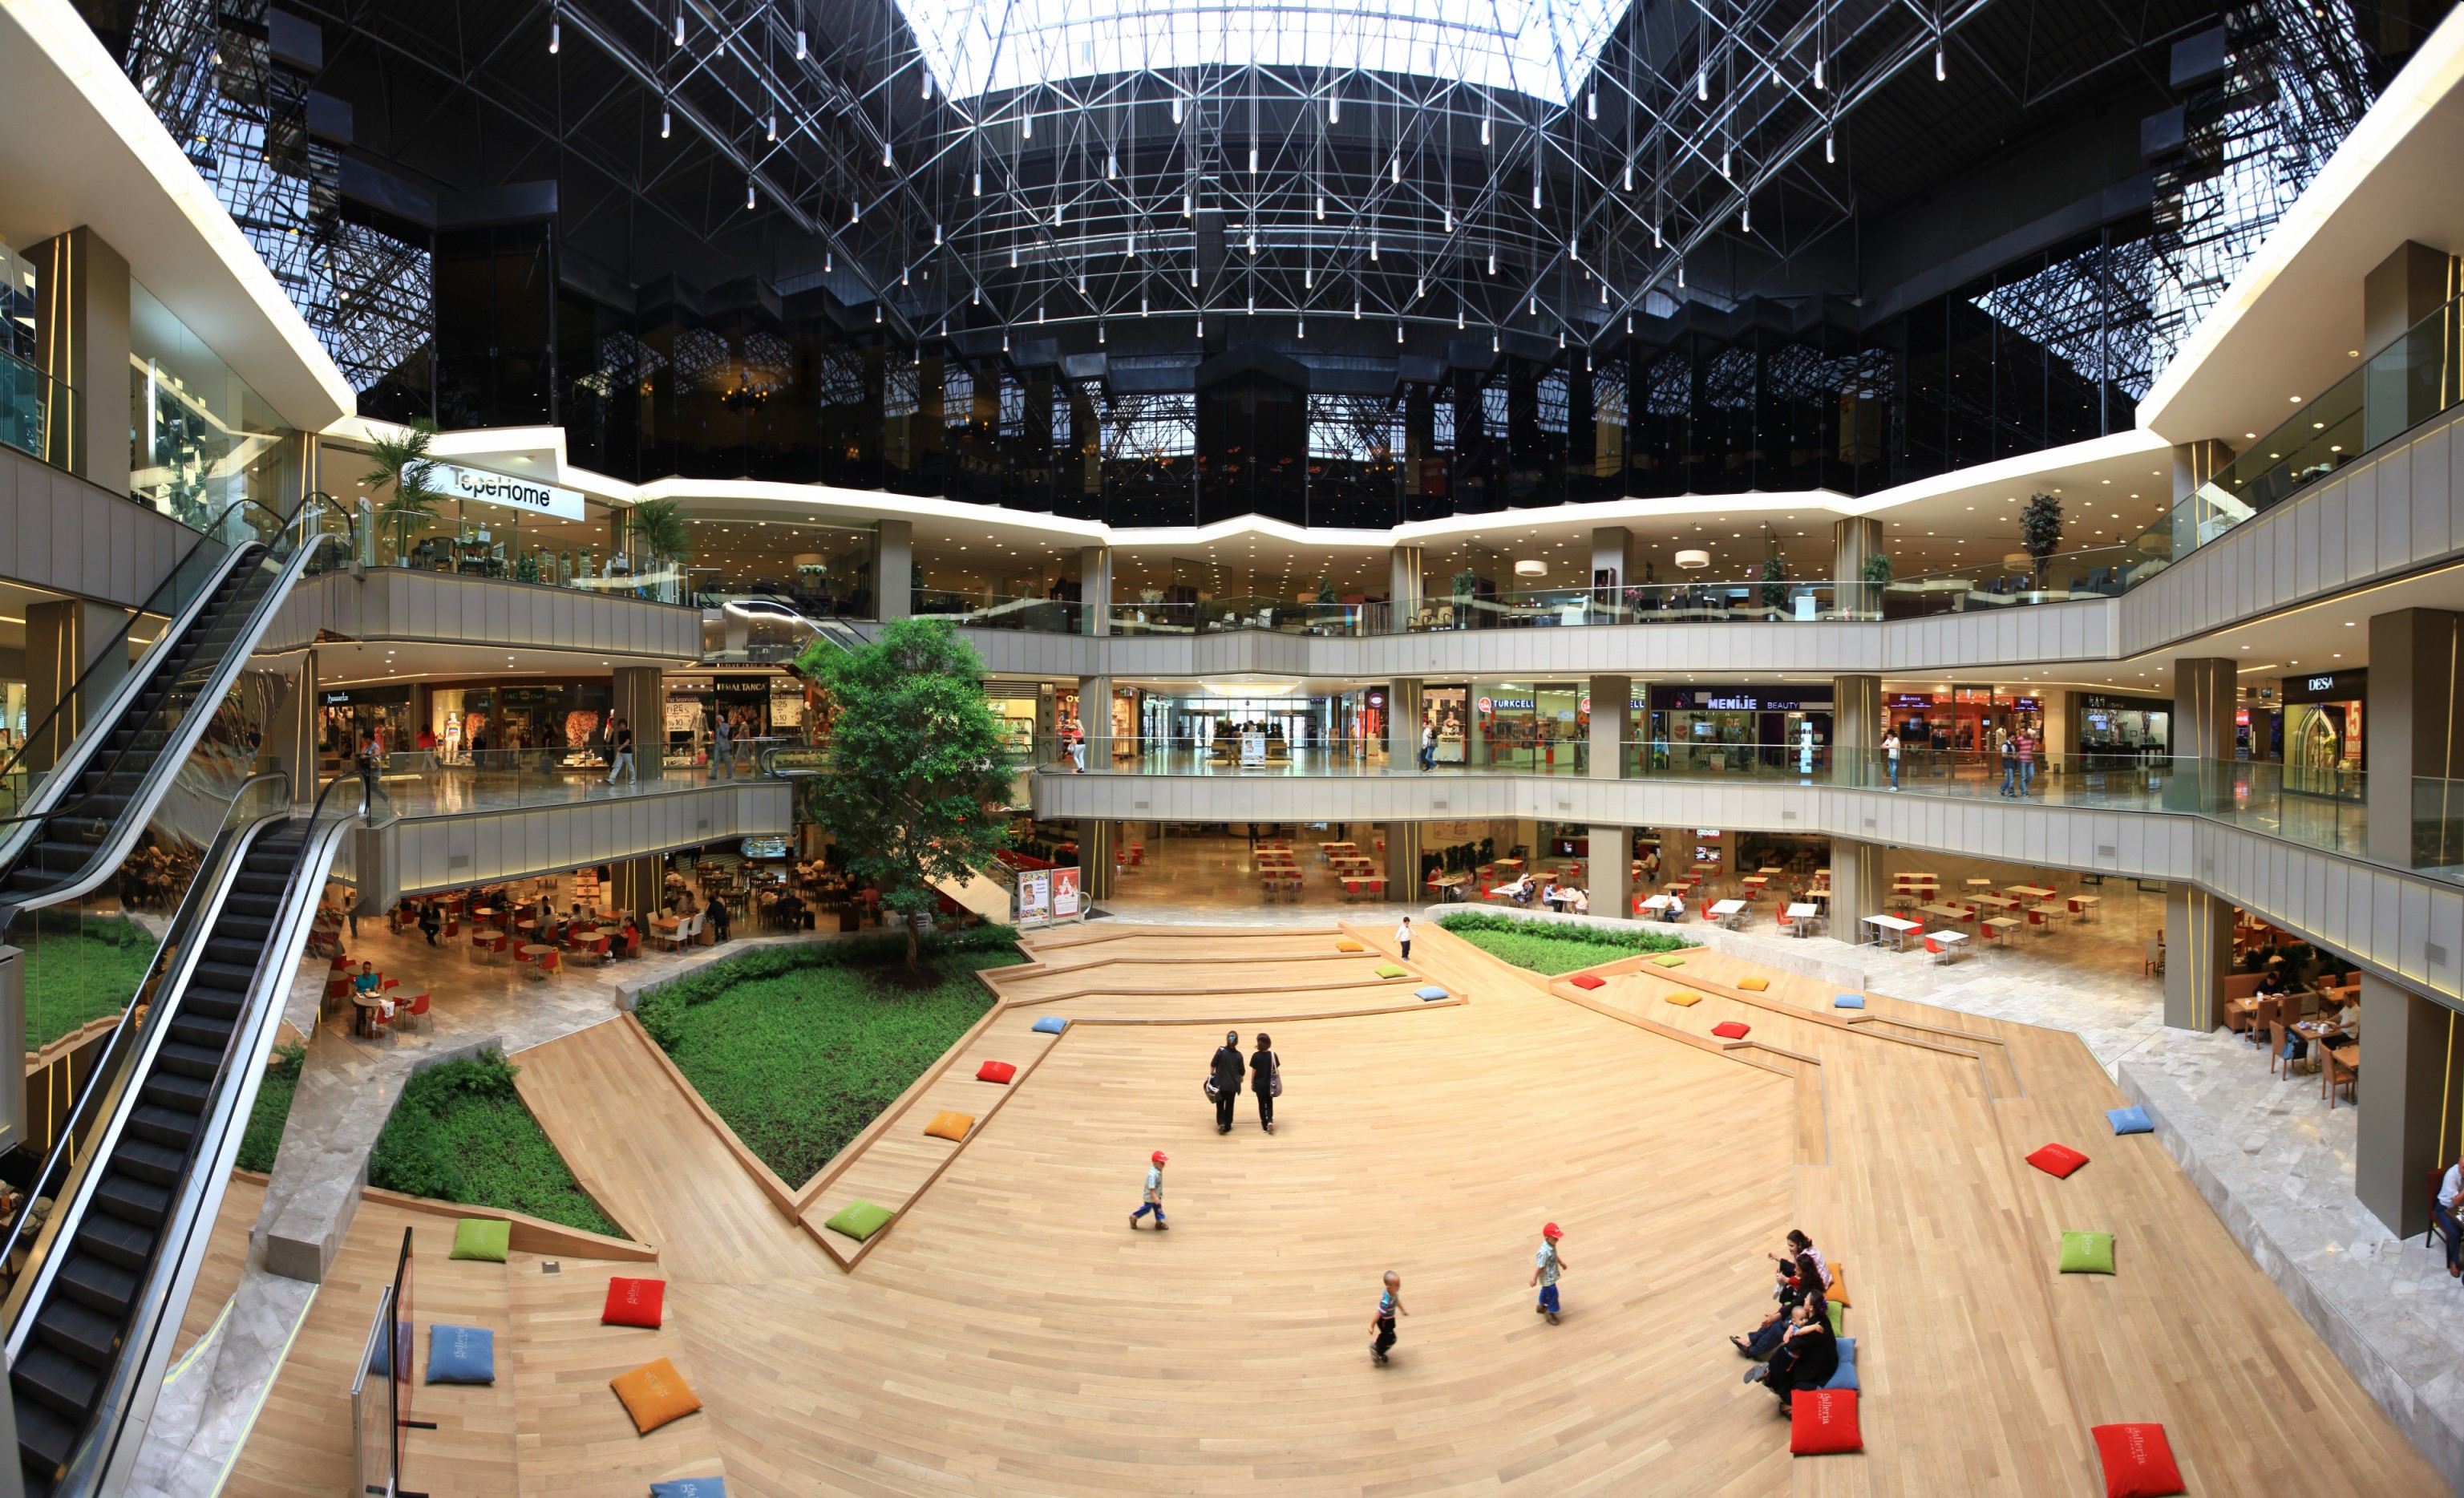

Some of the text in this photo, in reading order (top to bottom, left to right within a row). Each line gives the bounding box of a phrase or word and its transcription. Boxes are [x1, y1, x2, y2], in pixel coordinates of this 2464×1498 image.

[449, 467, 550, 507] TepeHome
[742, 683, 766, 691] TANCA
[2308, 677, 2334, 691] DESA
[1817, 1393, 1832, 1425] galleria
[2125, 1427, 2148, 1465] galleria
